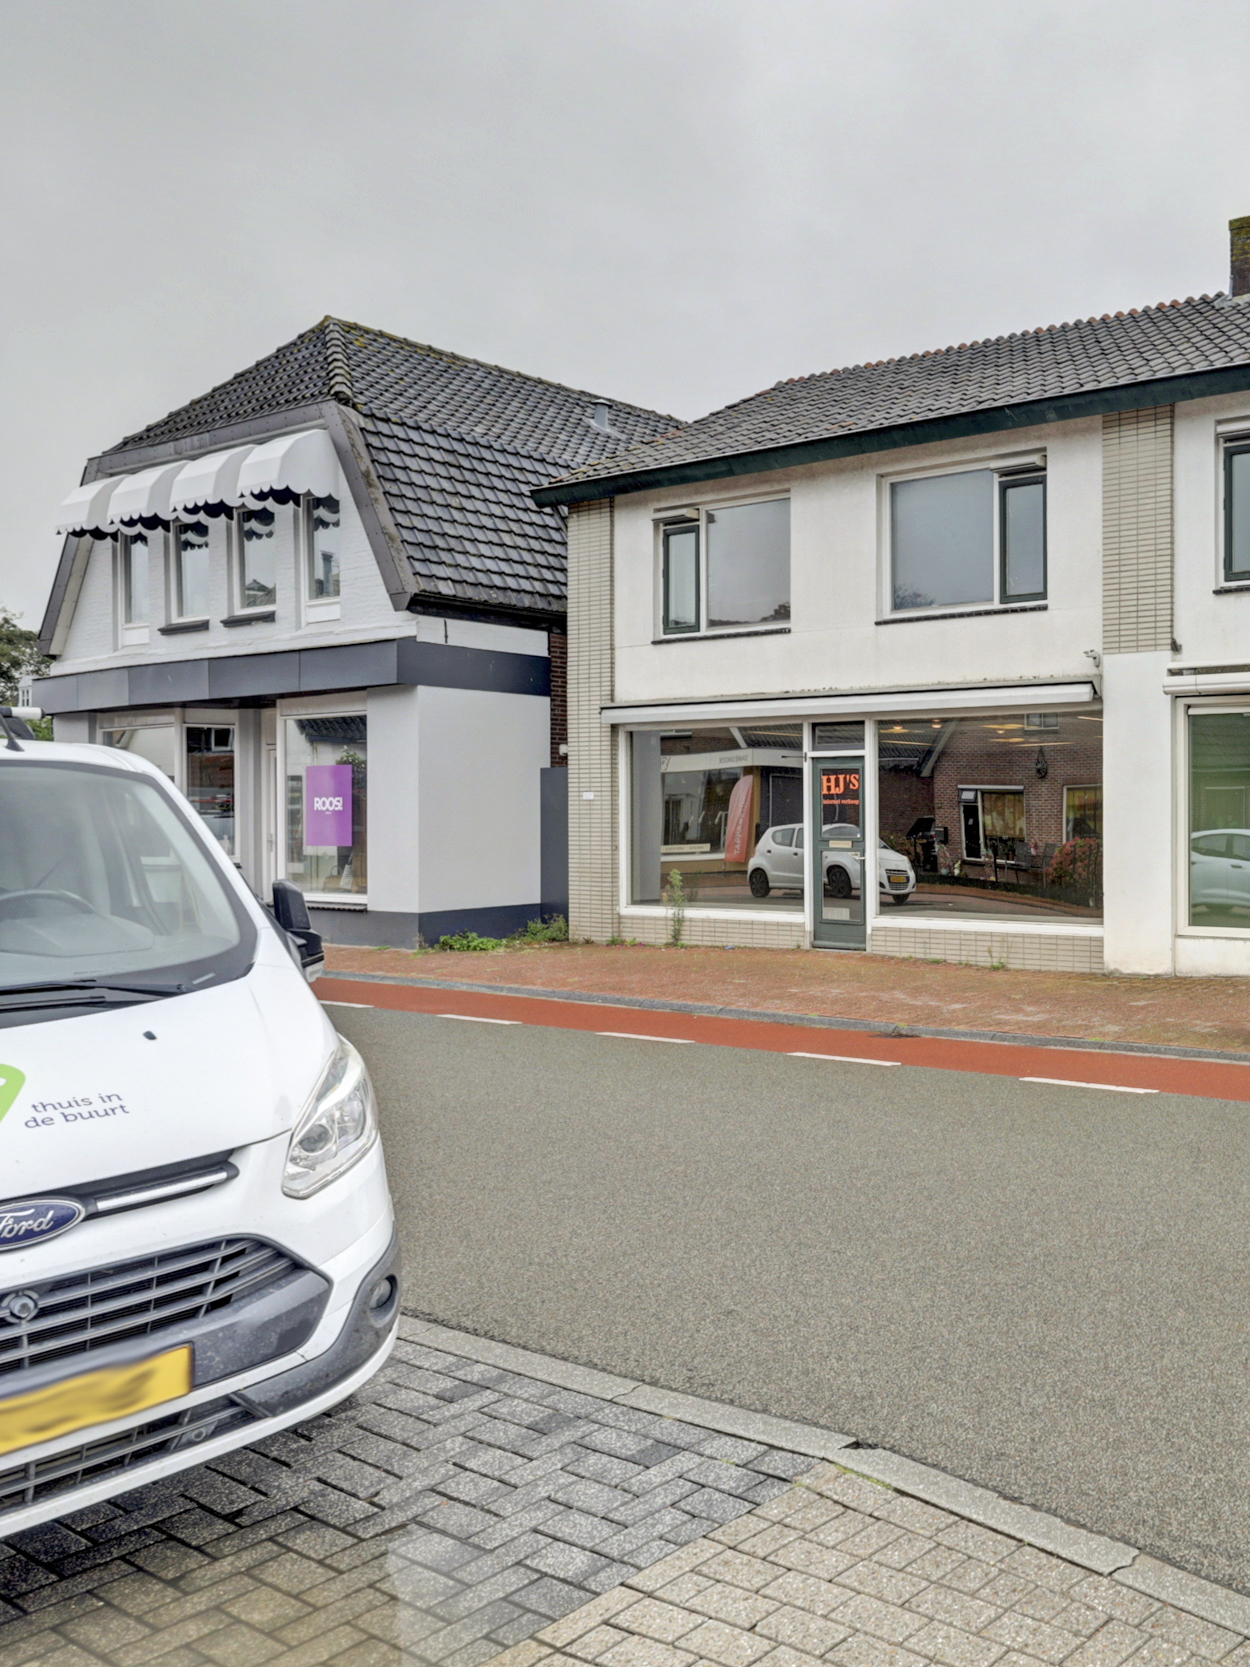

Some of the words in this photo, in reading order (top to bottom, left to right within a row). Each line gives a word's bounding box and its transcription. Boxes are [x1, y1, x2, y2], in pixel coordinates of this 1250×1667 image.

[821, 774, 860, 795] HJ'S
[314, 797, 343, 811] ROOS!
[31, 1097, 93, 1113] thuis
[98, 1093, 124, 1103] in
[24, 1116, 55, 1129] de
[60, 1104, 130, 1123] buurt
[0, 1208, 54, 1238] Ford
